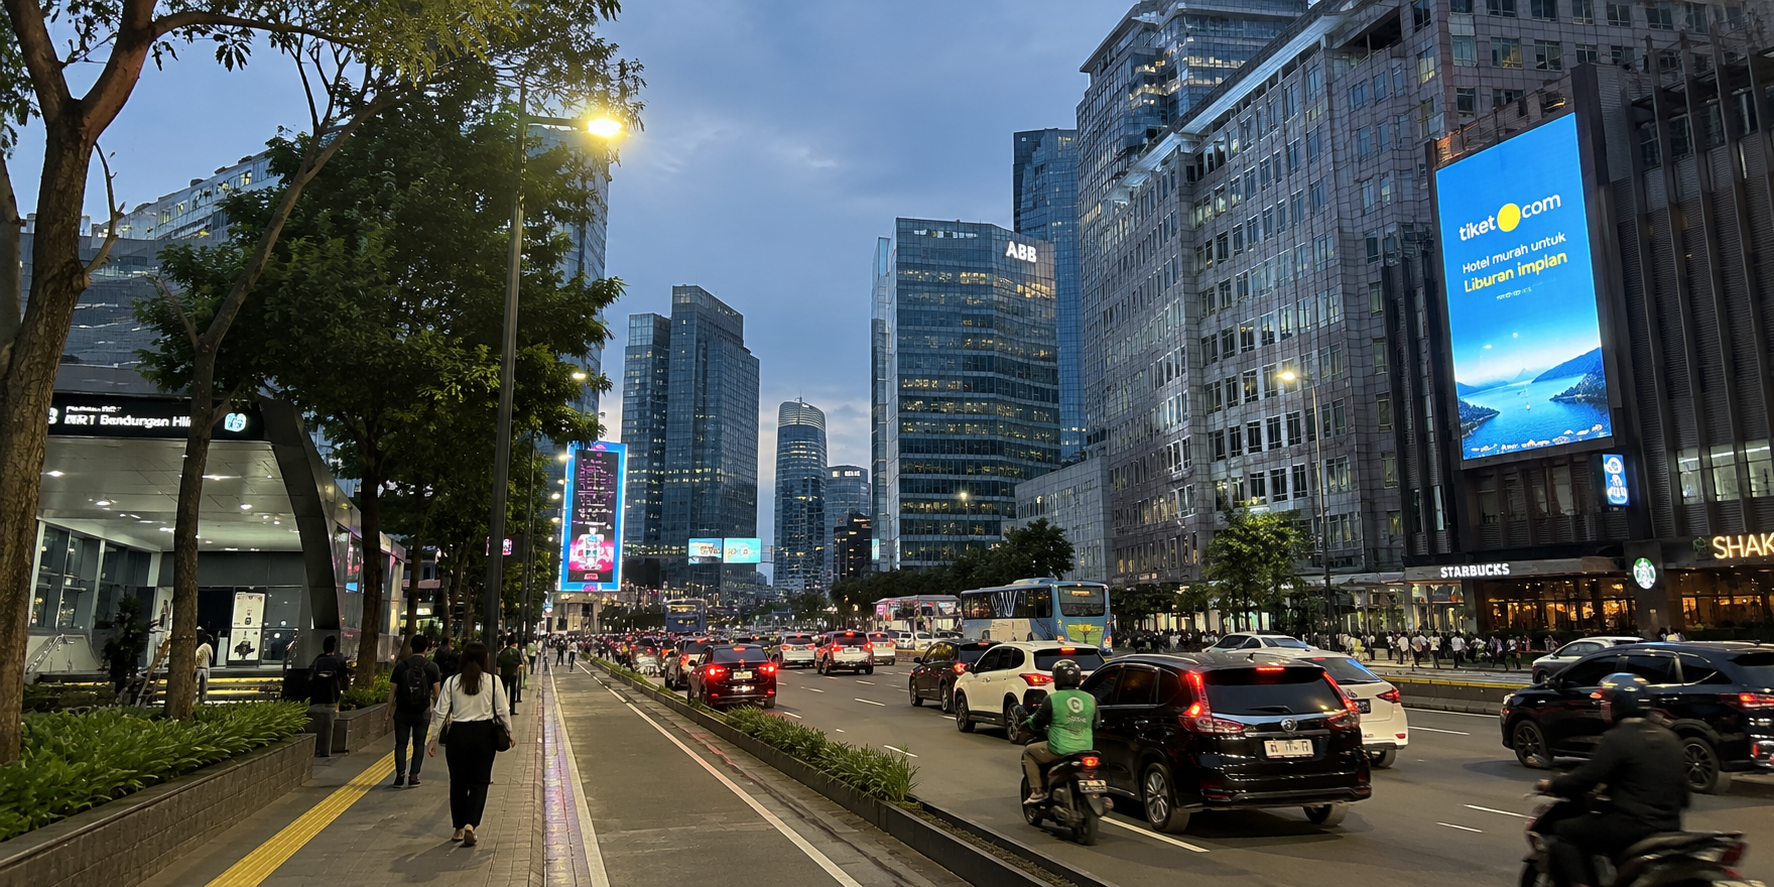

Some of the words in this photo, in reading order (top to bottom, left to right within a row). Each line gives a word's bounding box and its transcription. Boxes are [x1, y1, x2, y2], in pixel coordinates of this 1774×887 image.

[1005, 240, 1037, 263] ABB
[1462, 256, 1490, 274] Hotel
[1492, 244, 1528, 265] murah
[1531, 231, 1567, 251] untuk
[1464, 268, 1515, 293] Liburan
[1712, 532, 1774, 560] SHAK
[1440, 562, 1511, 579] STARBUCKS
